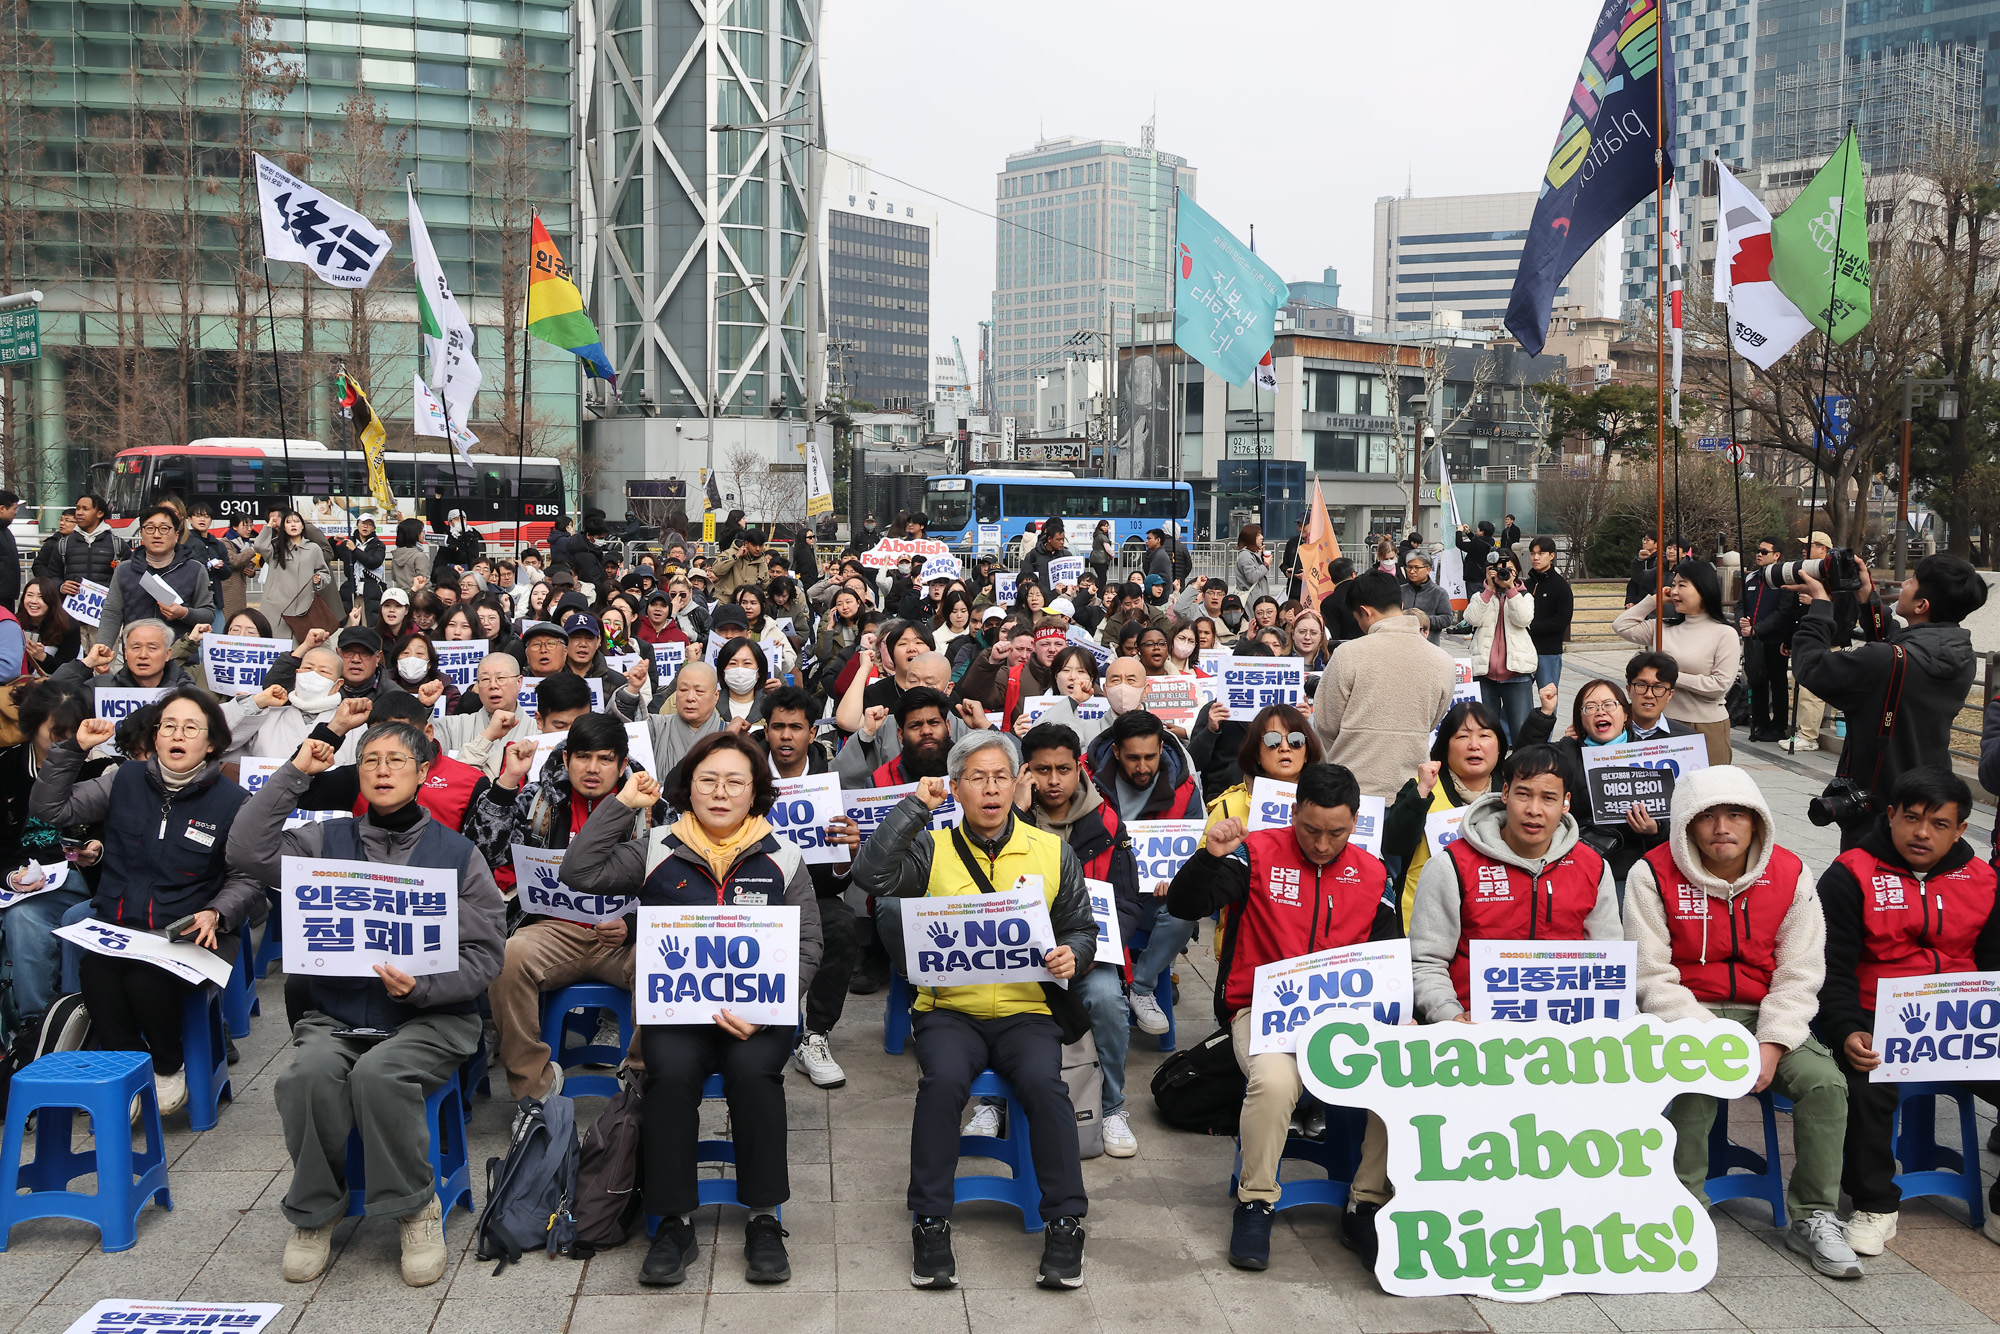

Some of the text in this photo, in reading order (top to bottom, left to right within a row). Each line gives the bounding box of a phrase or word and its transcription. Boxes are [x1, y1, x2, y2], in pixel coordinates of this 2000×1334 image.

[1476, 428, 1493, 436] TEXAS
[1418, 489, 1436, 499] LIVE
[220, 501, 259, 516] 9301
[1130, 520, 1142, 530] 103
[878, 539, 947, 555] Abolish
[936, 558, 955, 567] NO
[1051, 562, 1082, 574] 인종차별
[921, 566, 960, 578] RACISM
[1225, 670, 1300, 686] 인종차별
[1884, 711, 1893, 727] EOS
[1627, 745, 1658, 754] International
[1659, 746, 1694, 755] Discrimination
[1603, 780, 1663, 797] 예외 없이
[765, 800, 815, 827] NO
[1148, 836, 1197, 857] NO
[1270, 866, 1300, 884] 단결
[1478, 865, 1510, 881] 단결
[1269, 881, 1300, 900] 투쟁
[1478, 880, 1510, 897] 투쟁
[1871, 875, 1904, 892] 단결
[295, 885, 448, 916] 인종차별
[963, 900, 1006, 908] International
[1678, 897, 1709, 914] 투쟁
[1874, 888, 1905, 906] 투쟁
[964, 918, 1031, 948] NO
[695, 935, 760, 969] NO
[918, 948, 1054, 973] RACISM
[1310, 952, 1349, 965] International
[1288, 964, 1321, 974] Elimination
[1329, 958, 1348, 966] Racial
[1349, 954, 1395, 963] Discrimination
[1308, 968, 1374, 1001] NO
[1483, 965, 1627, 993] 인종차별
[1923, 980, 1996, 989] 2026 International Day
[648, 972, 785, 1004] RACISM
[1915, 988, 1950, 996] Elimination
[1935, 999, 2000, 1031] NO
[1307, 1022, 1749, 1090] Guarantee
[1884, 1032, 2000, 1065] RACIS
[1409, 1113, 1662, 1181] Labor
[1390, 1205, 1698, 1292] Rights!
[97, 1311, 262, 1328] 인종차별
